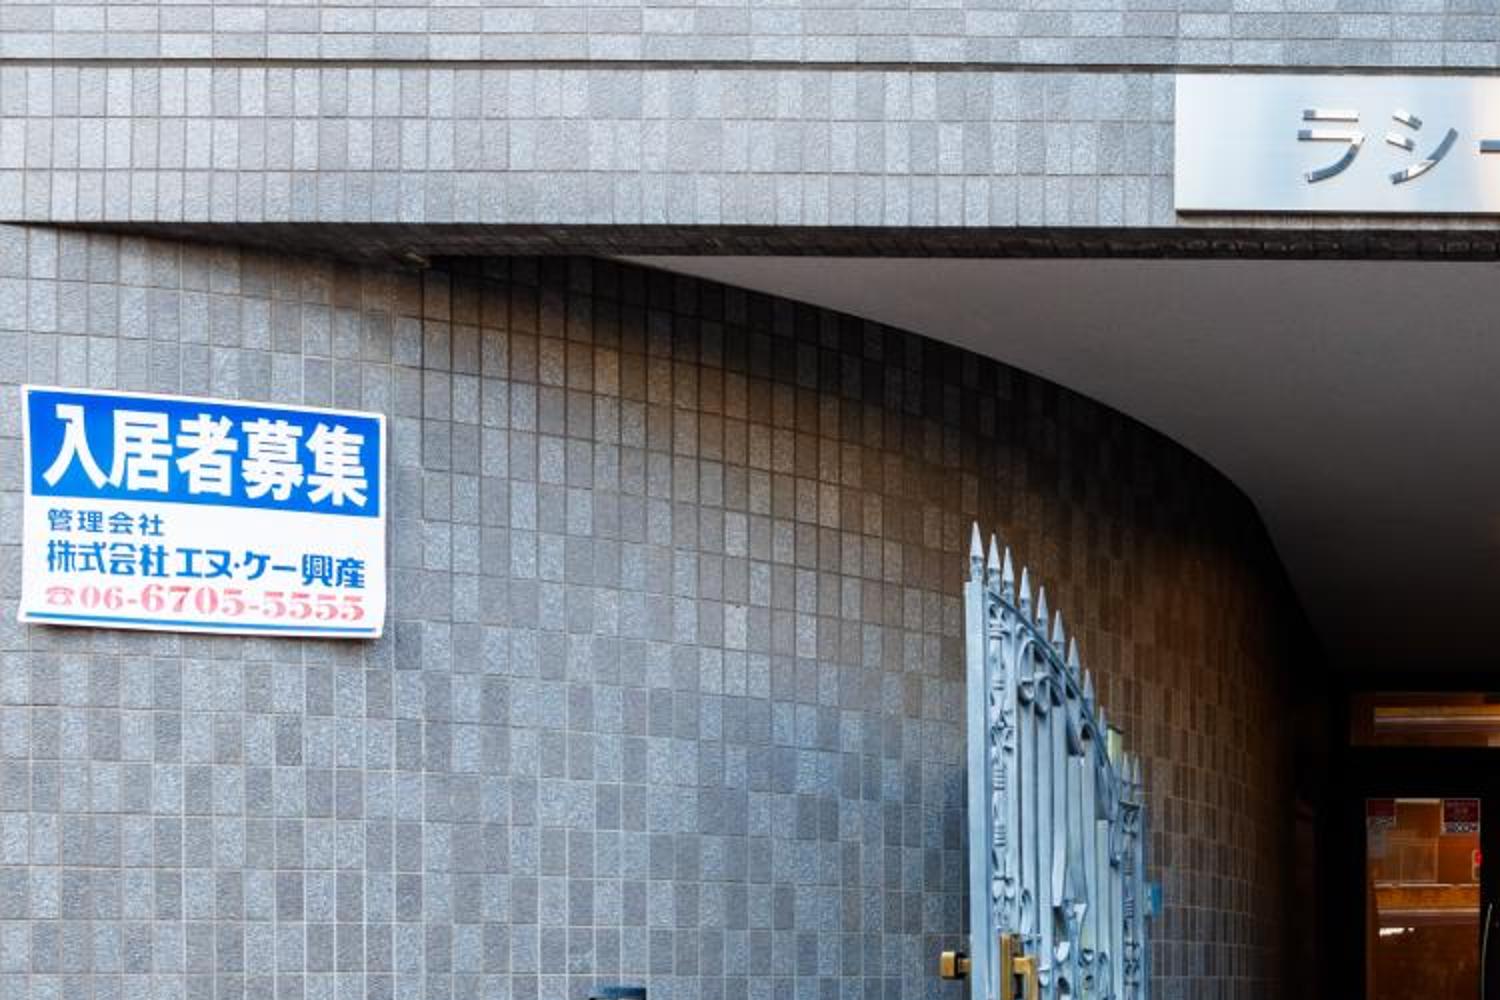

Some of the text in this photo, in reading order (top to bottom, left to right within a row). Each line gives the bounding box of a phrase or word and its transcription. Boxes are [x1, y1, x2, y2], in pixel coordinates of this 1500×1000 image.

[42, 404, 368, 508] 入居者募集
[47, 508, 164, 537] 管理会社
[47, 539, 366, 589] 株式会社エヌ・ケー興産
